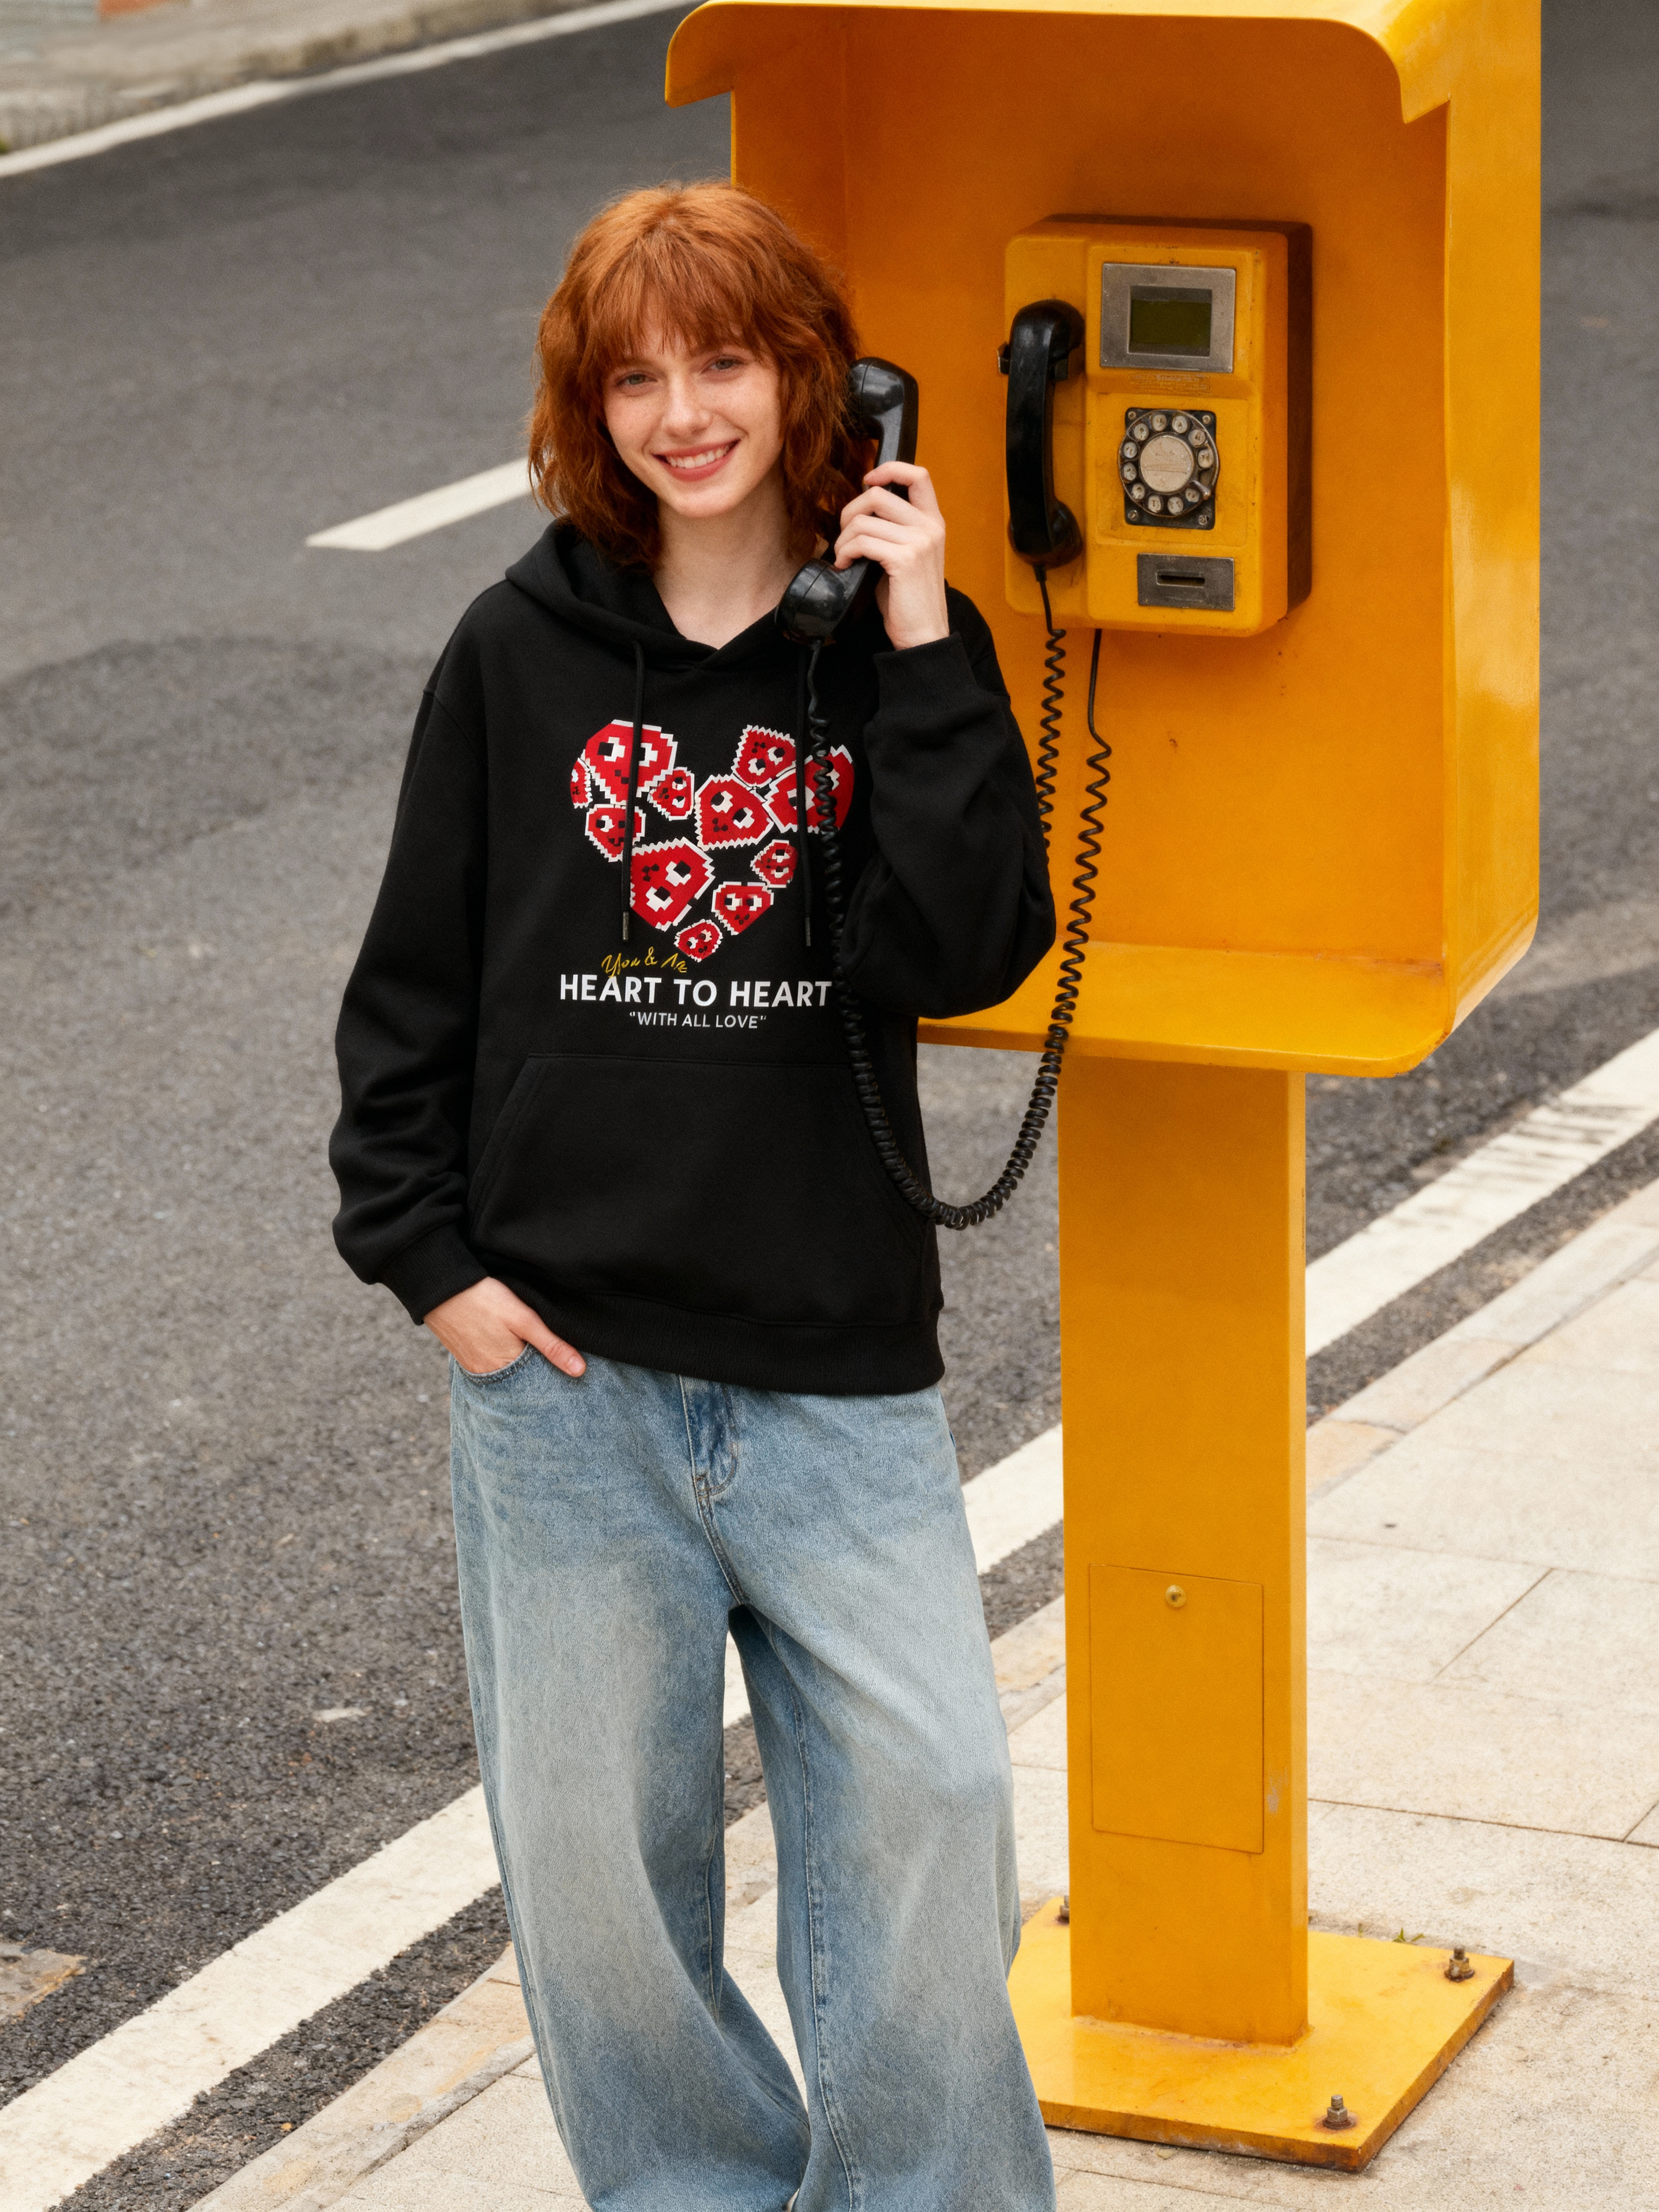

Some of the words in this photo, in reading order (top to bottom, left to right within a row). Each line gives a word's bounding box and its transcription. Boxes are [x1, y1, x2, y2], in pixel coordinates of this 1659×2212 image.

[601, 953, 641, 979] You
[644, 946, 658, 966] &
[560, 974, 662, 1003] HEART
[673, 979, 717, 1007] TO
[730, 981, 832, 1008] HEART
[682, 1013, 711, 1028] ALL
